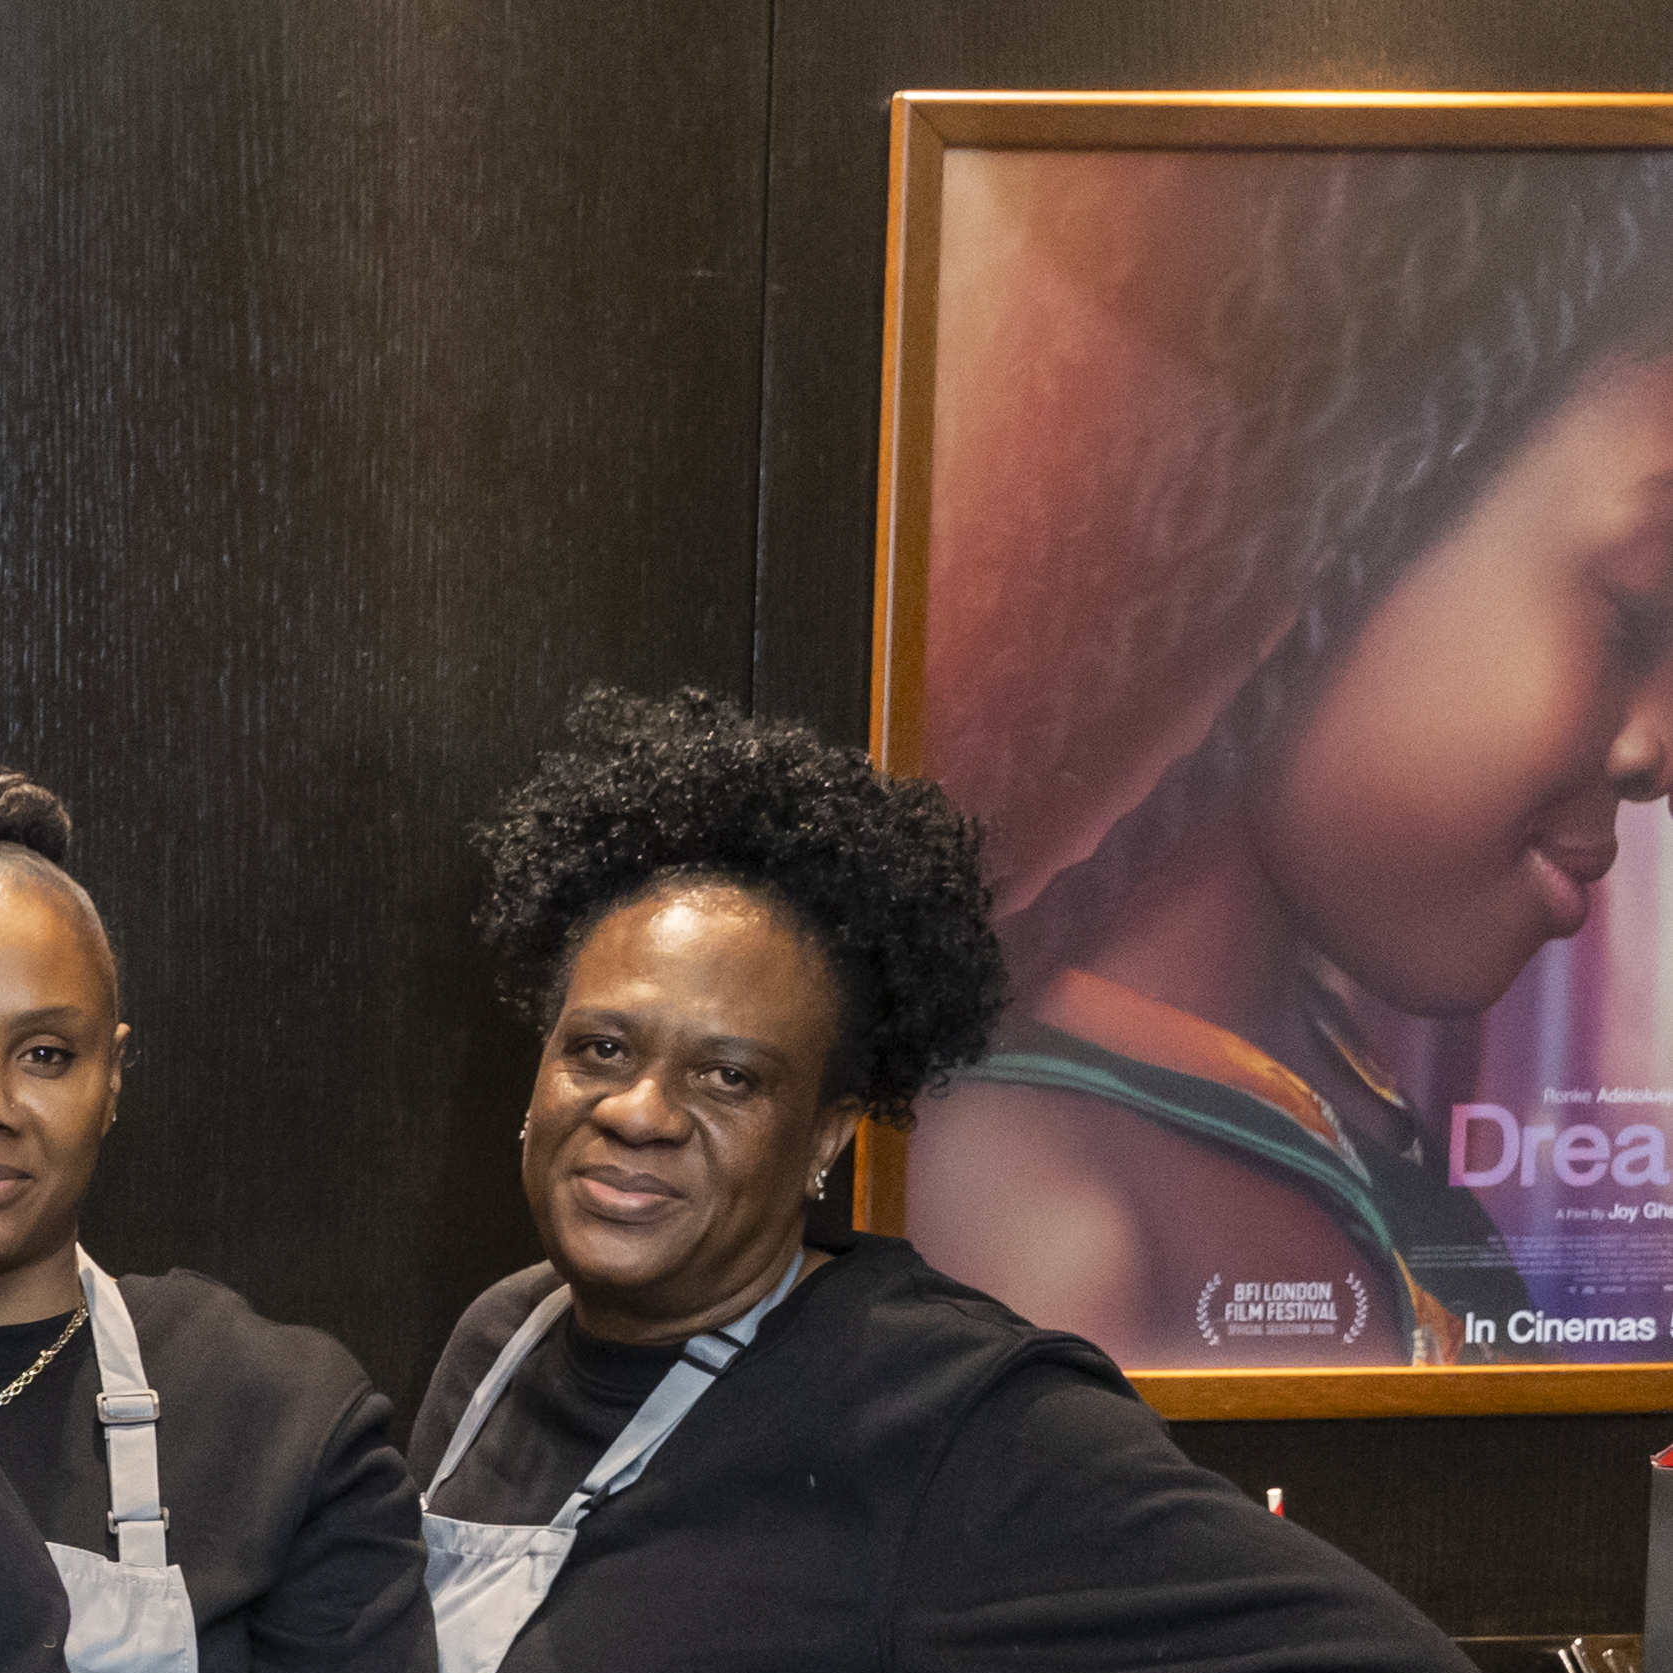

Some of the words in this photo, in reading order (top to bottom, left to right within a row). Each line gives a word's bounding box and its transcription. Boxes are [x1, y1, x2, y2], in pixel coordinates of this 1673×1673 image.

[1448, 1103, 1672, 1187] Drea
[1607, 1203, 1639, 1223] Joy
[1234, 1282, 1261, 1301] BFI
[1264, 1281, 1332, 1301] LONDON
[1224, 1302, 1265, 1321] FILM
[1267, 1301, 1338, 1321] FESTIVAL
[1465, 1311, 1497, 1344] In
[1507, 1309, 1657, 1344] Cinemas
